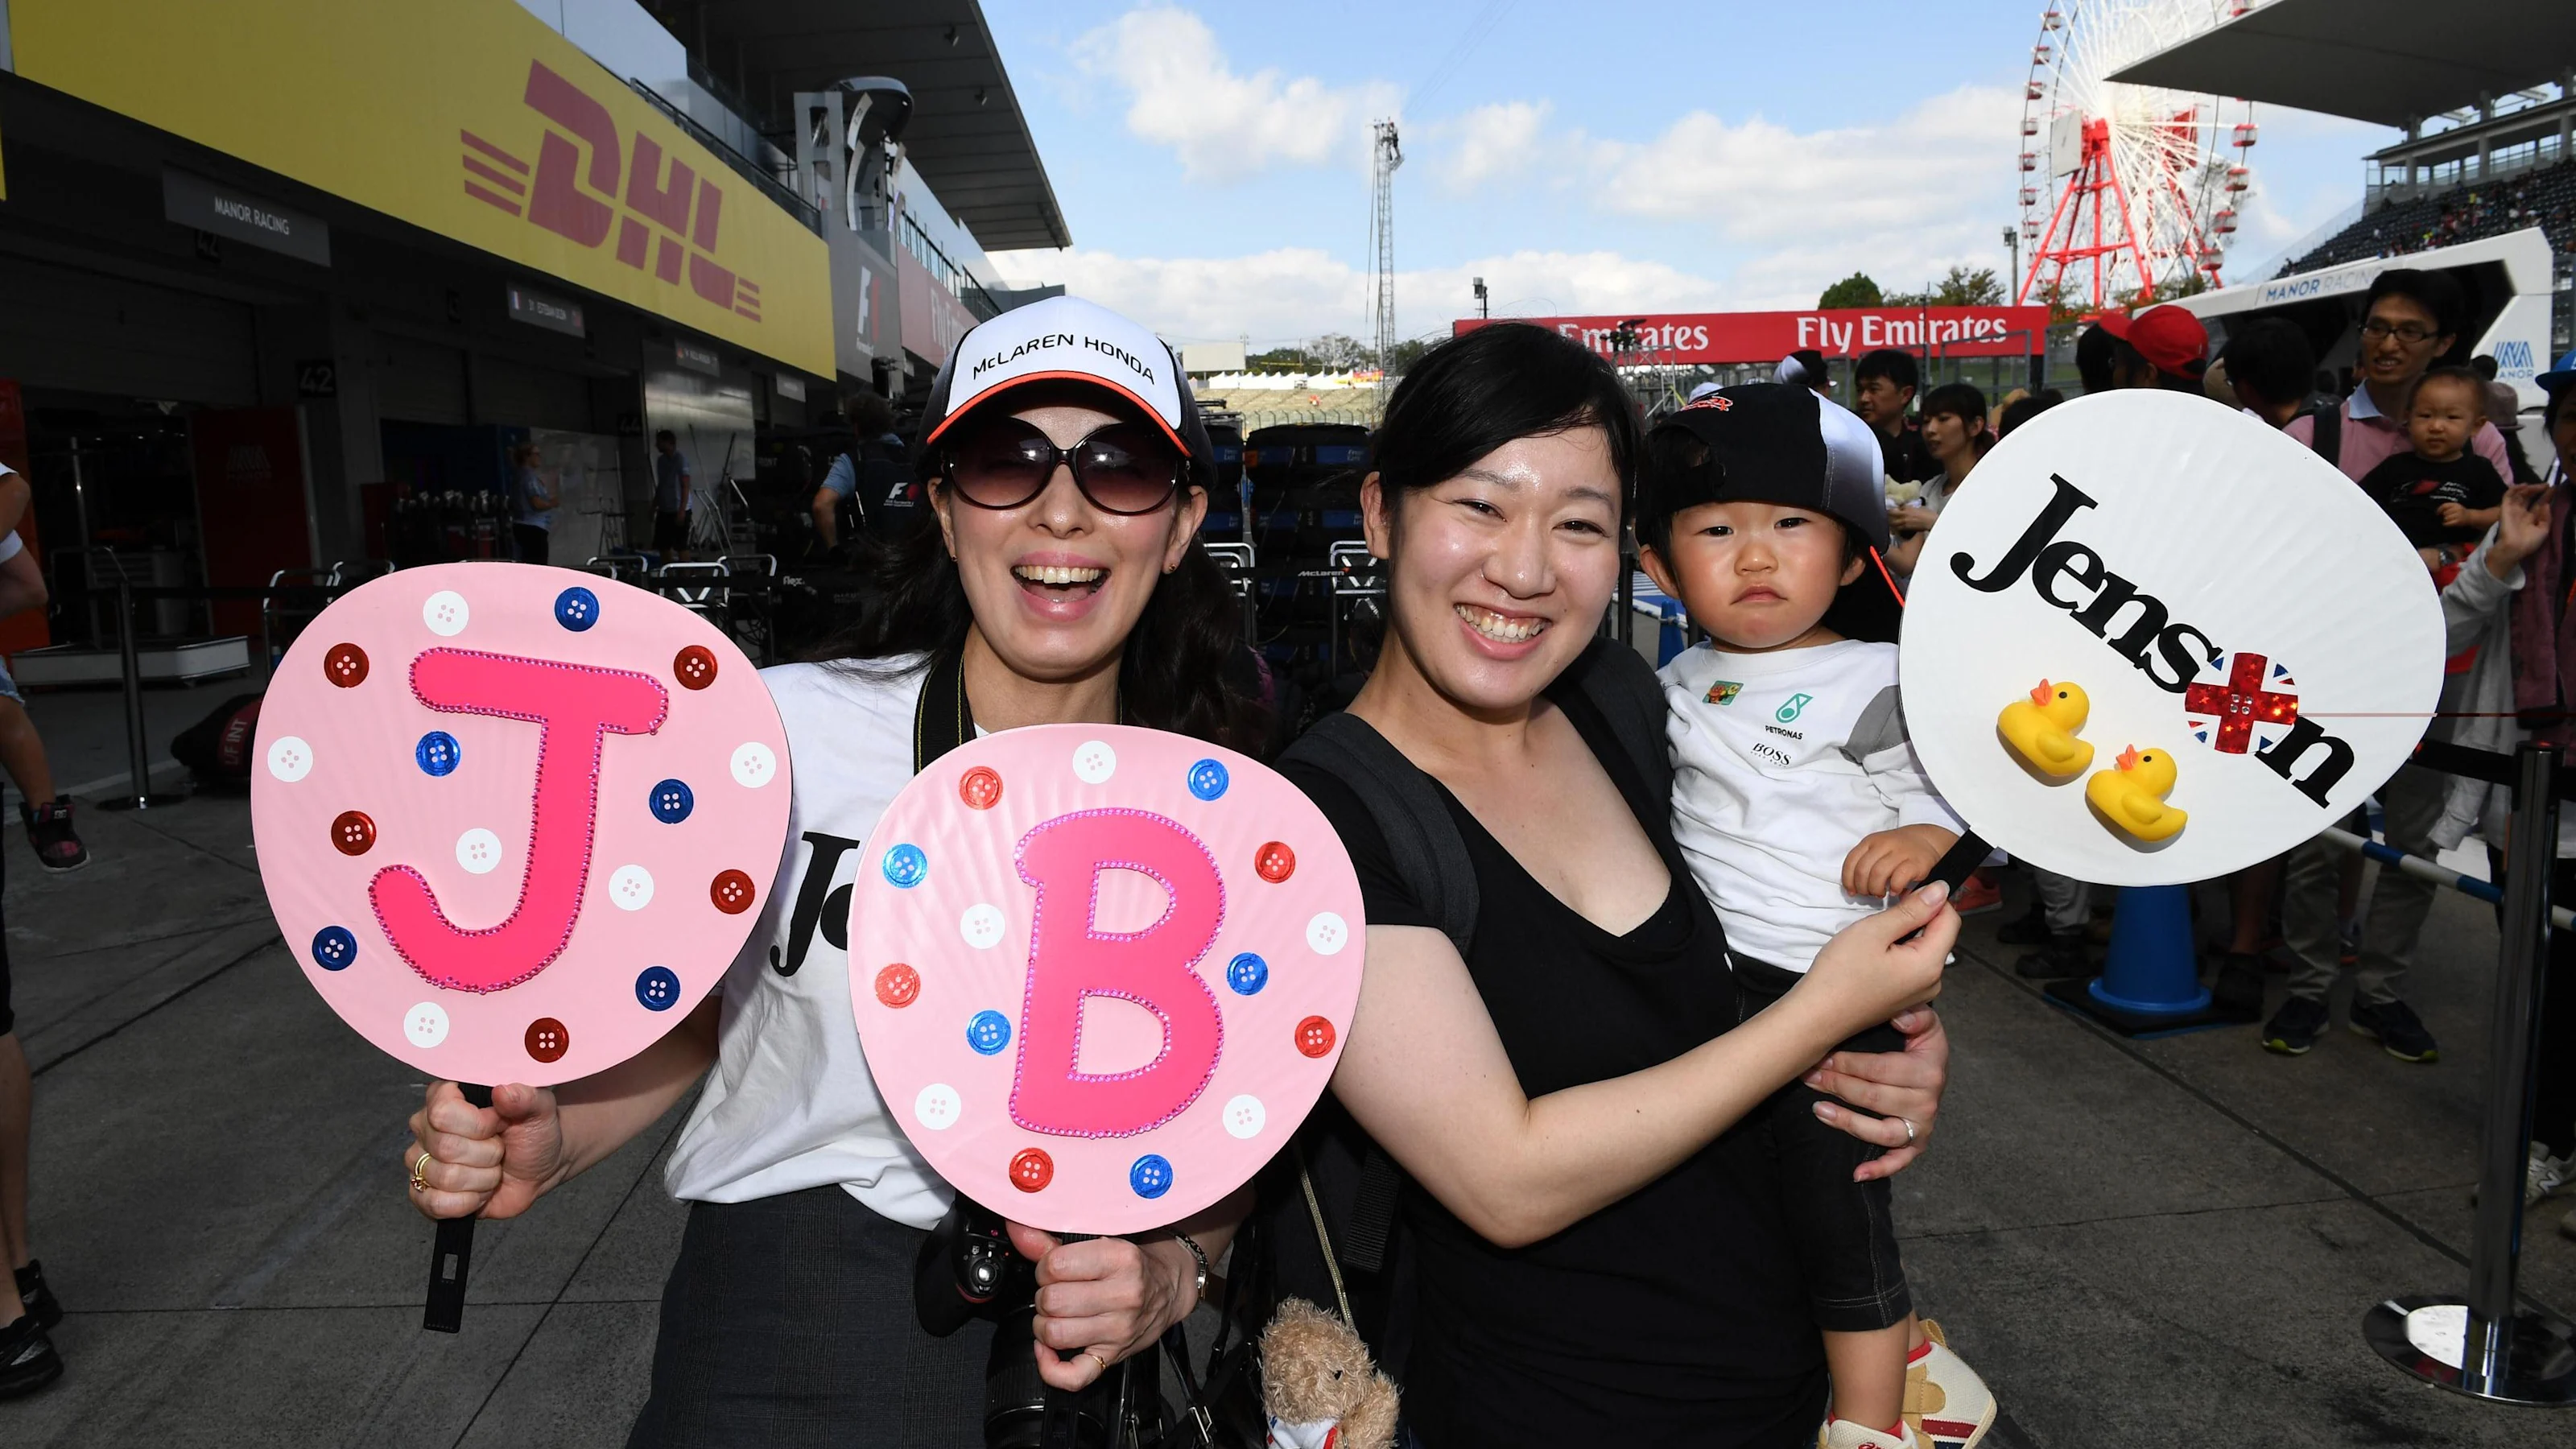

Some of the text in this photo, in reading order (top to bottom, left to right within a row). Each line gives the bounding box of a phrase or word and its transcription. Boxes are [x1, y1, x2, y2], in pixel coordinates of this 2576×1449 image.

[524, 59, 736, 310] DHL
[215, 196, 290, 237] MANOR RACING
[2265, 278, 2322, 303] MANOR
[1797, 312, 2007, 353] Fly Emirates
[972, 334, 1155, 386] McLAREN HONDA
[2496, 369, 2534, 379] ANOR
[300, 366, 334, 392] 42
[226, 718, 248, 744] INT
[1765, 725, 1803, 740] PETRONAS
[1752, 743, 1792, 766] BOSS
[368, 646, 669, 995] J
[1009, 807, 1227, 1139] B
